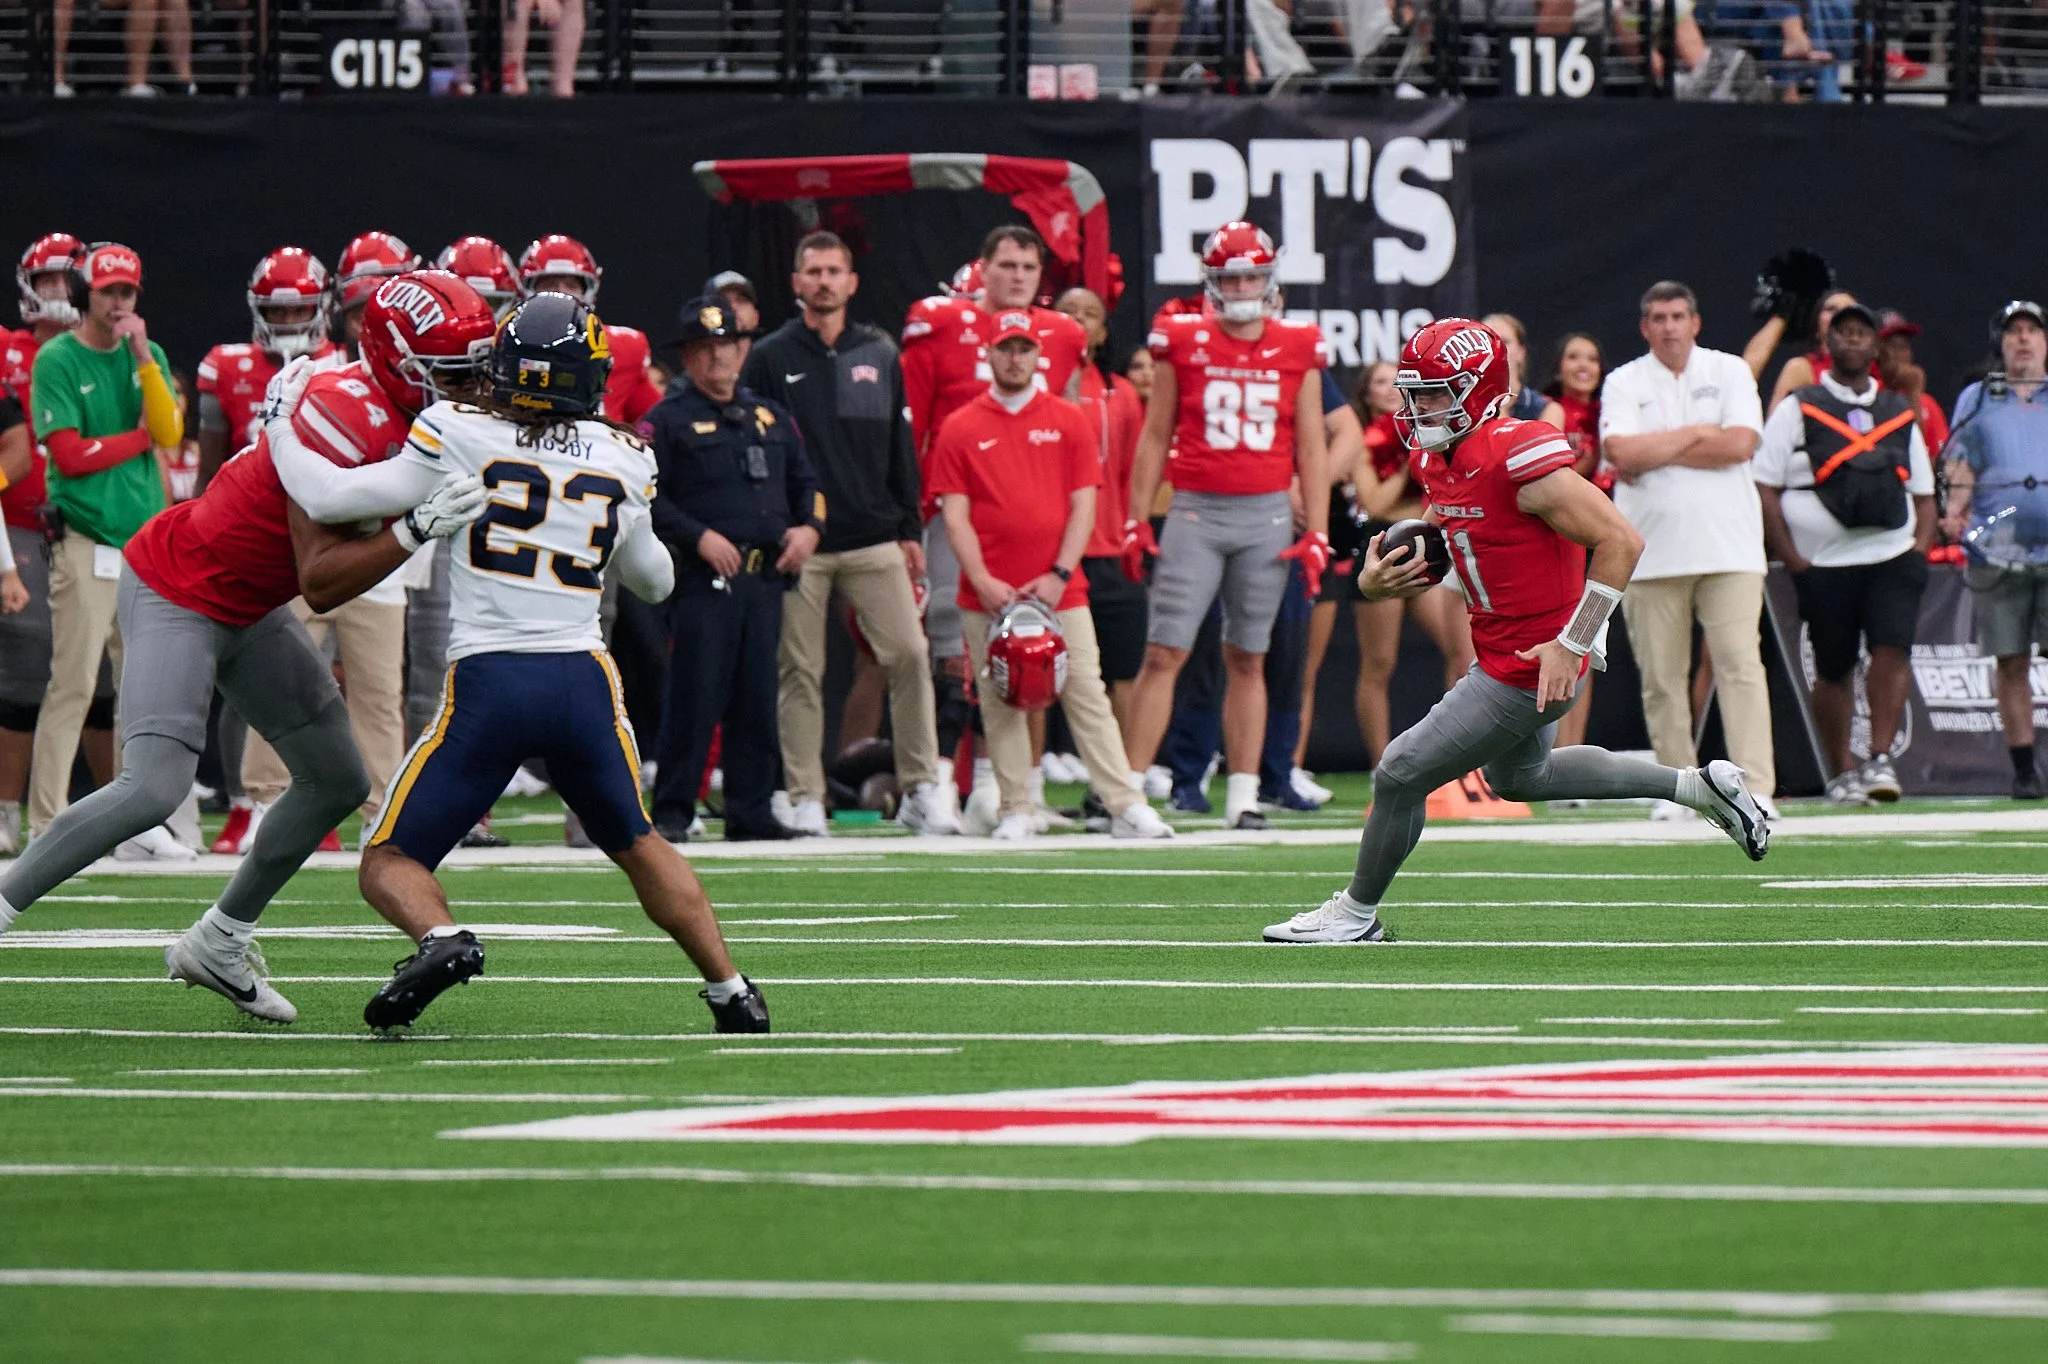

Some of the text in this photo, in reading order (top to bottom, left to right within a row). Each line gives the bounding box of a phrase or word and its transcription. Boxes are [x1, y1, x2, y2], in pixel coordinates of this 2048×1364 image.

[330, 38, 424, 89] C115
[1510, 36, 1595, 98] 116
[1150, 136, 1456, 287] PT'S
[378, 281, 446, 336] UNLV
[1437, 329, 1494, 371] UNLV
[1203, 380, 1281, 452] 85
[469, 457, 628, 595] 23
[1912, 663, 1993, 699] IBEW
